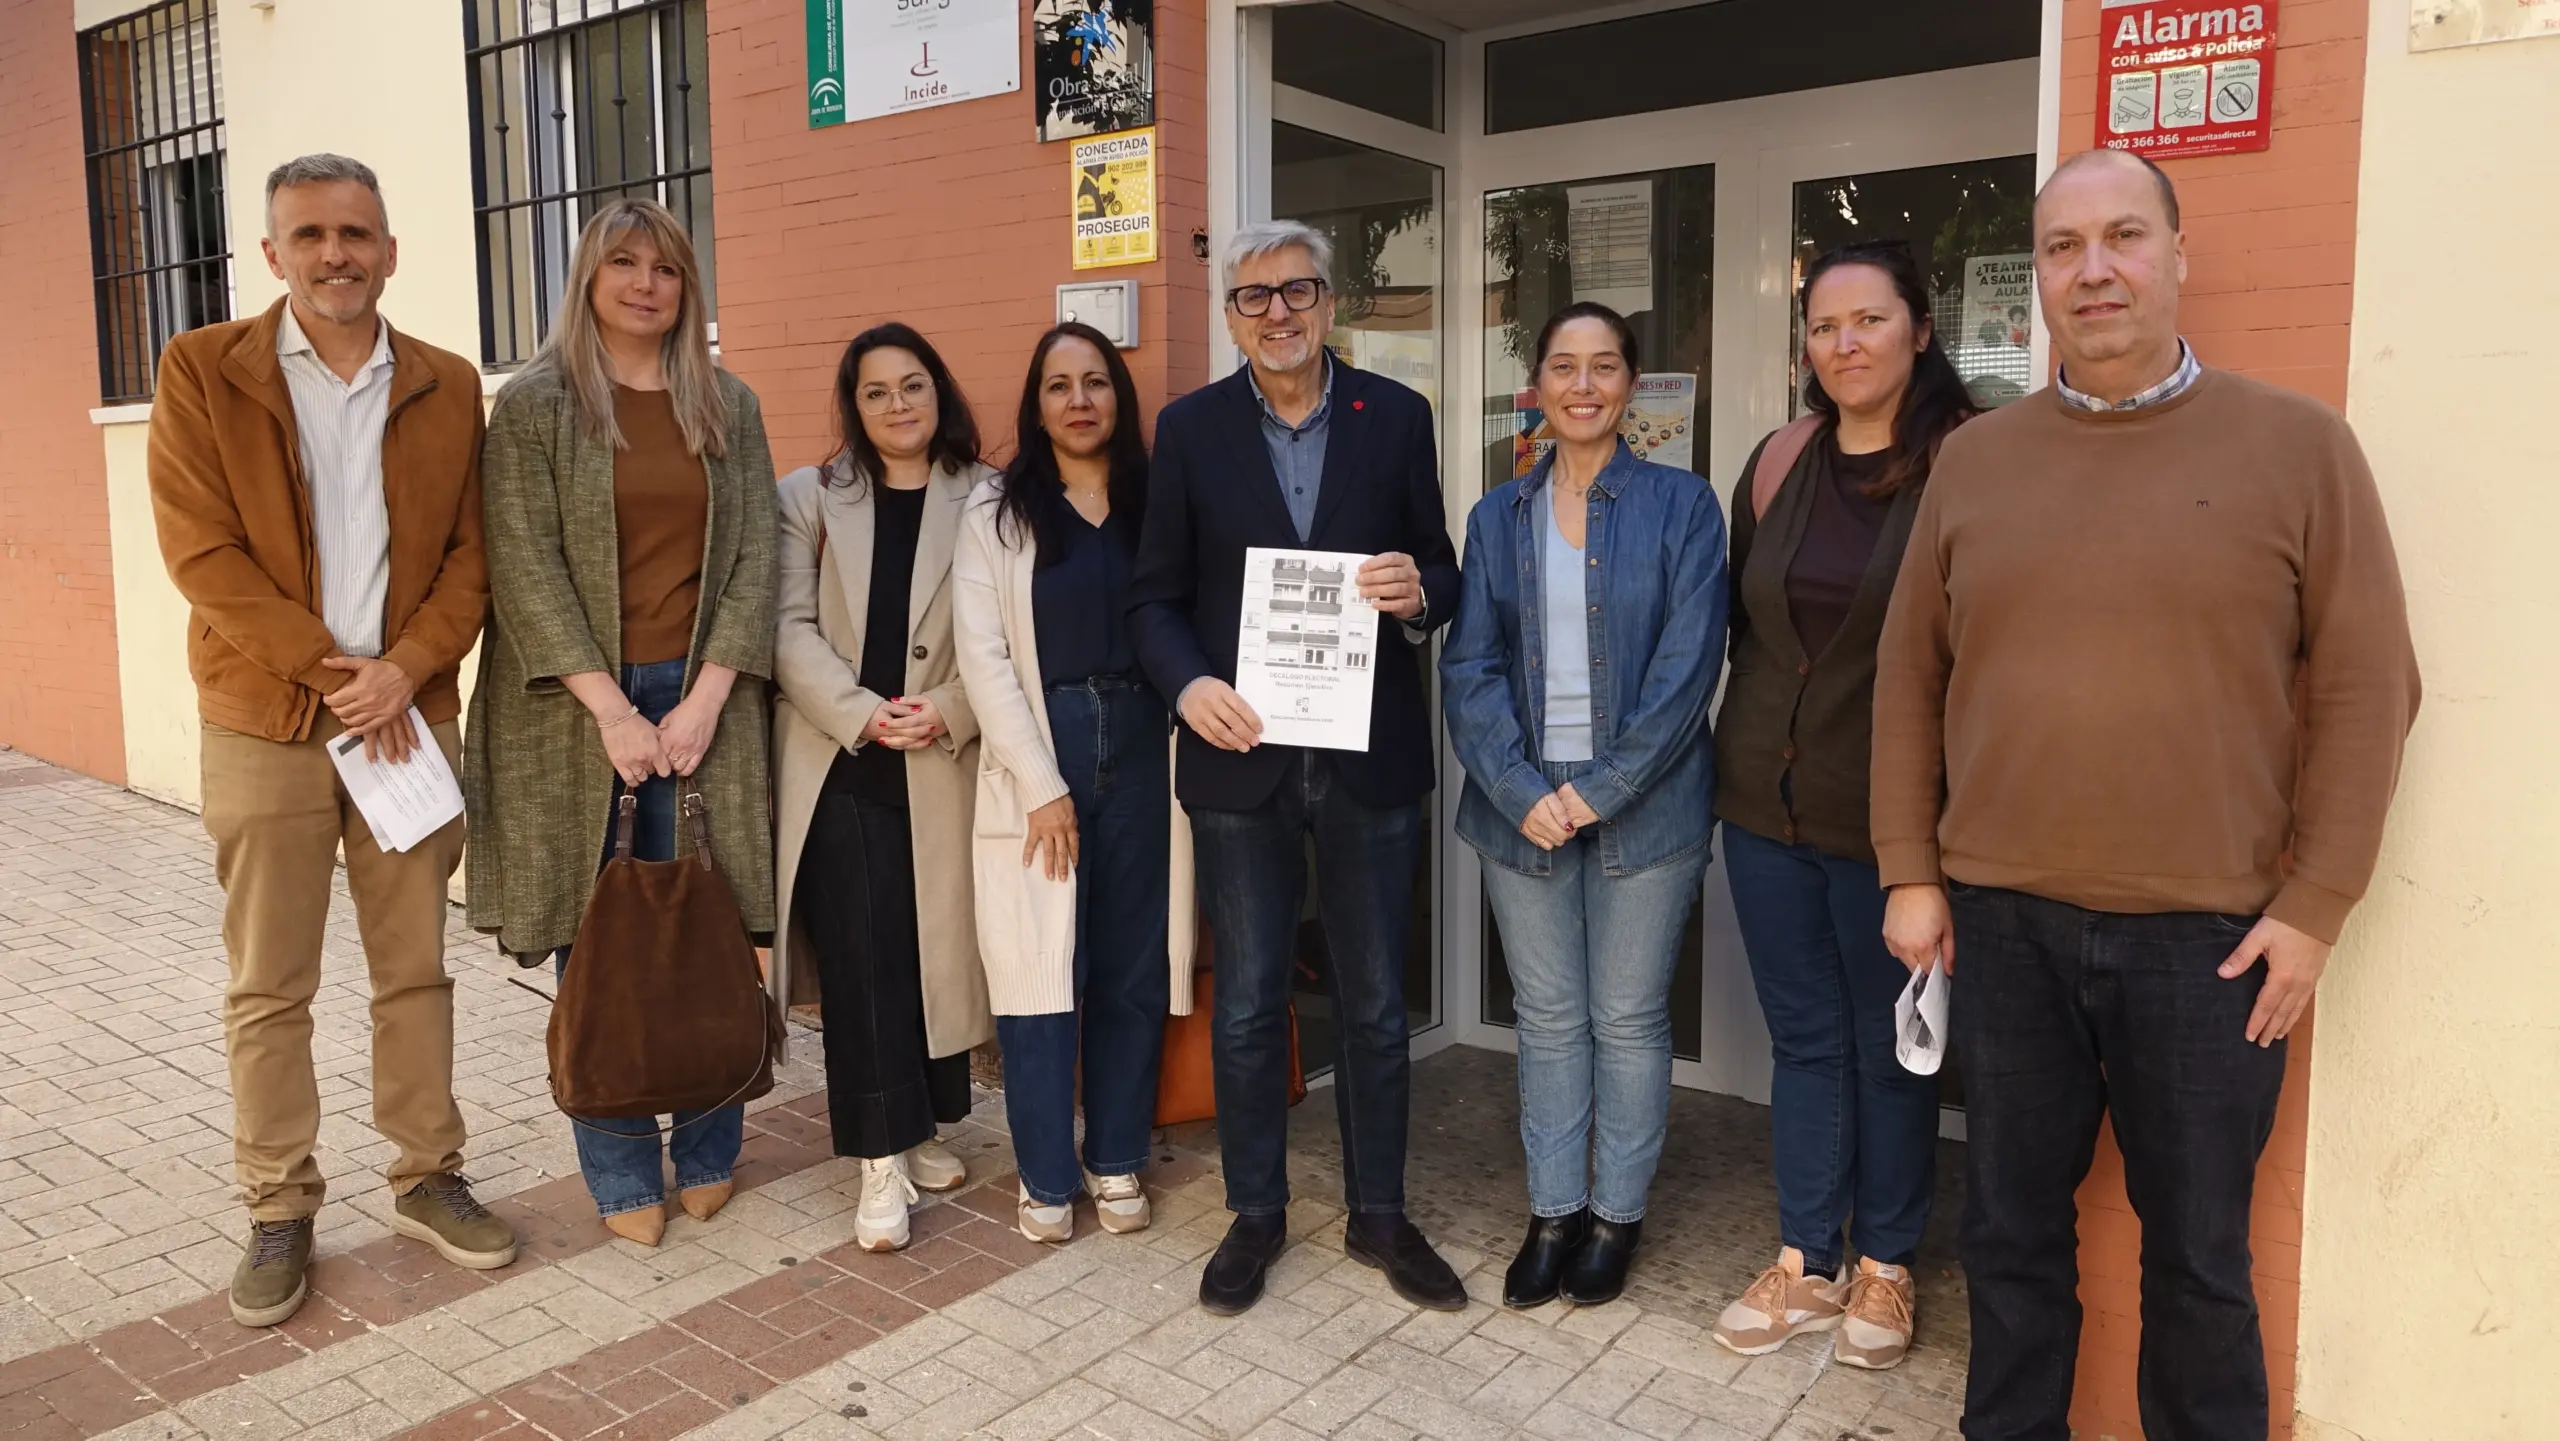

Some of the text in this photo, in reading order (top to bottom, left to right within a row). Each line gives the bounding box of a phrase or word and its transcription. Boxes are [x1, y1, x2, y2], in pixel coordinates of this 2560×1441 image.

[2112, 4, 2264, 48] Alarma
[2111, 53, 2140, 68] con
[2144, 46, 2187, 65] aviso
[2168, 70, 2202, 80] Vigilante
[2224, 63, 2250, 73] Alarma
[904, 81, 948, 101] Incide
[1048, 76, 1090, 99] Obra
[1076, 137, 1149, 158] CONECTADA
[2107, 138, 2129, 149] 902
[2131, 136, 2154, 148] 366
[2156, 134, 2180, 146] 366
[2186, 129, 2257, 143] securitasdirect.es
[1107, 164, 1120, 173] 902
[1077, 216, 1150, 237] PROSEGUR
[1991, 274, 2027, 285] SALIR
[1664, 379, 1682, 390] RED
